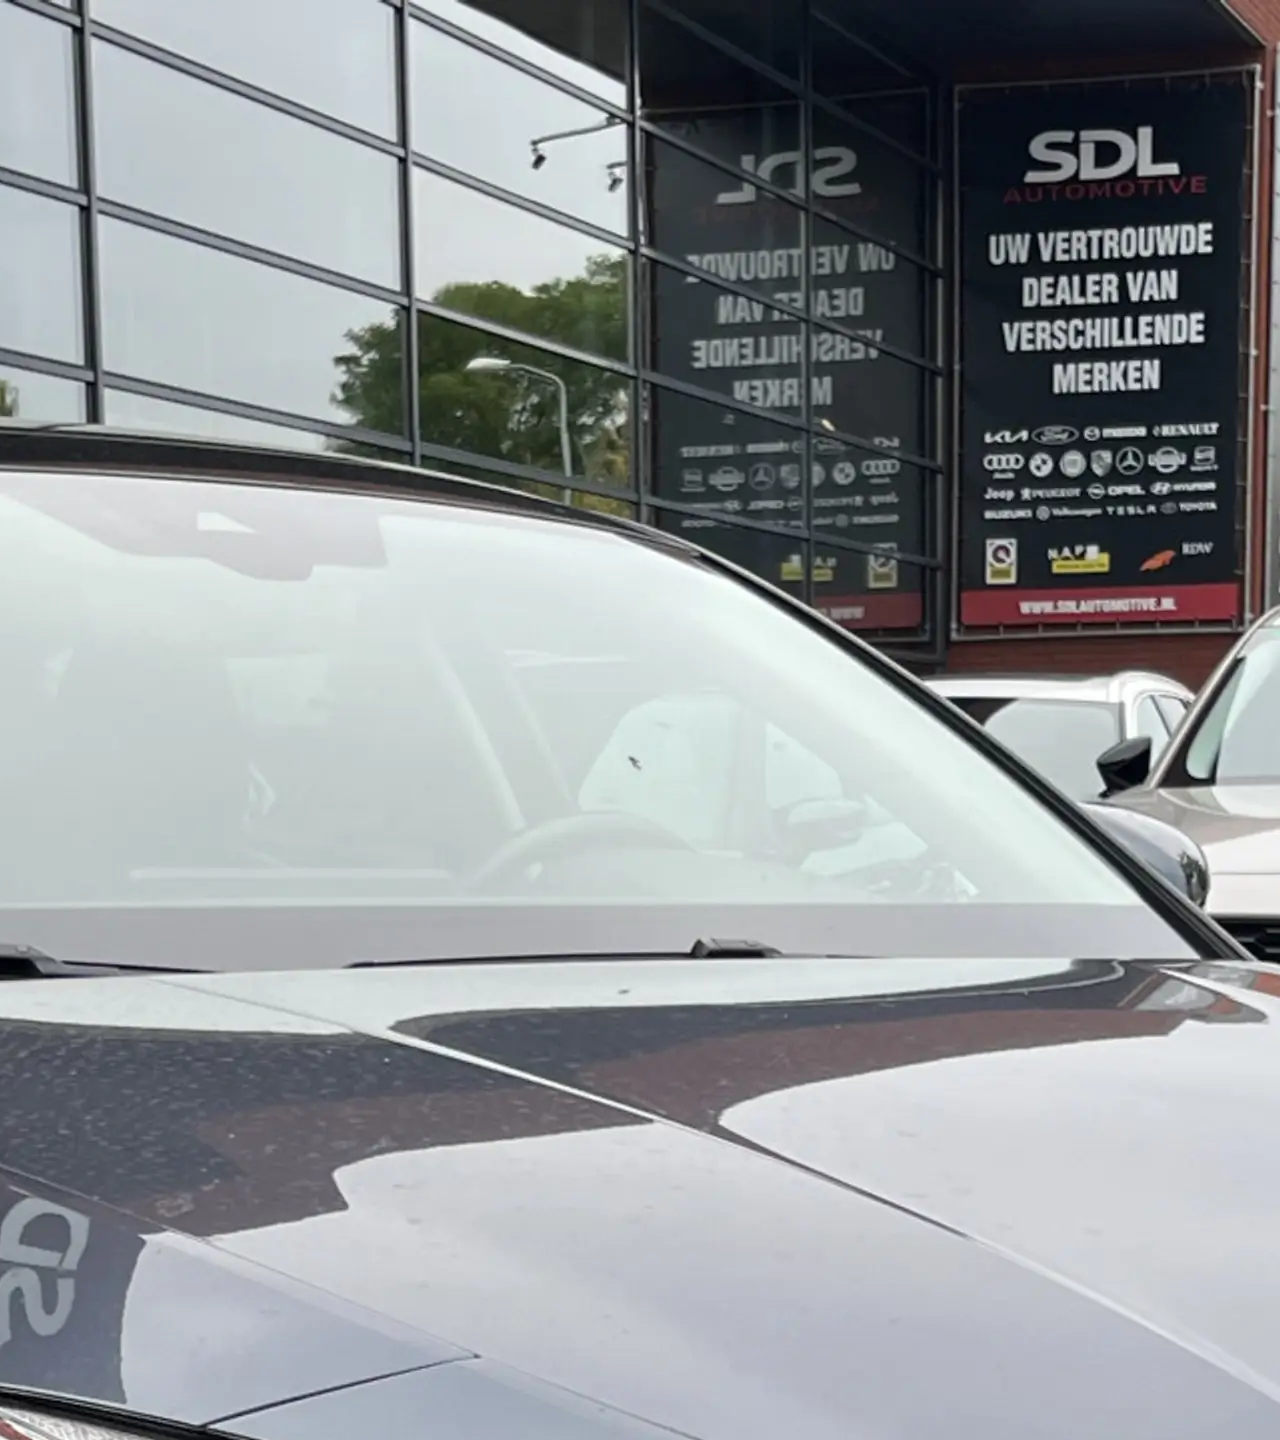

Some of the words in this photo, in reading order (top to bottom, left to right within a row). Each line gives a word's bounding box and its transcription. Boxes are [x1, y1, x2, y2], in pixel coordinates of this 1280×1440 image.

[1024, 125, 1180, 183] SDL
[1004, 176, 1208, 203] AUTOMOTIVE
[988, 233, 1031, 265] UW
[1038, 222, 1213, 262] VERTROUWDE
[1022, 273, 1119, 307] DEALER
[1126, 269, 1178, 302] VAN
[1002, 312, 1205, 352] VERSCHILLENDE
[1053, 359, 1160, 394] MERKEN
